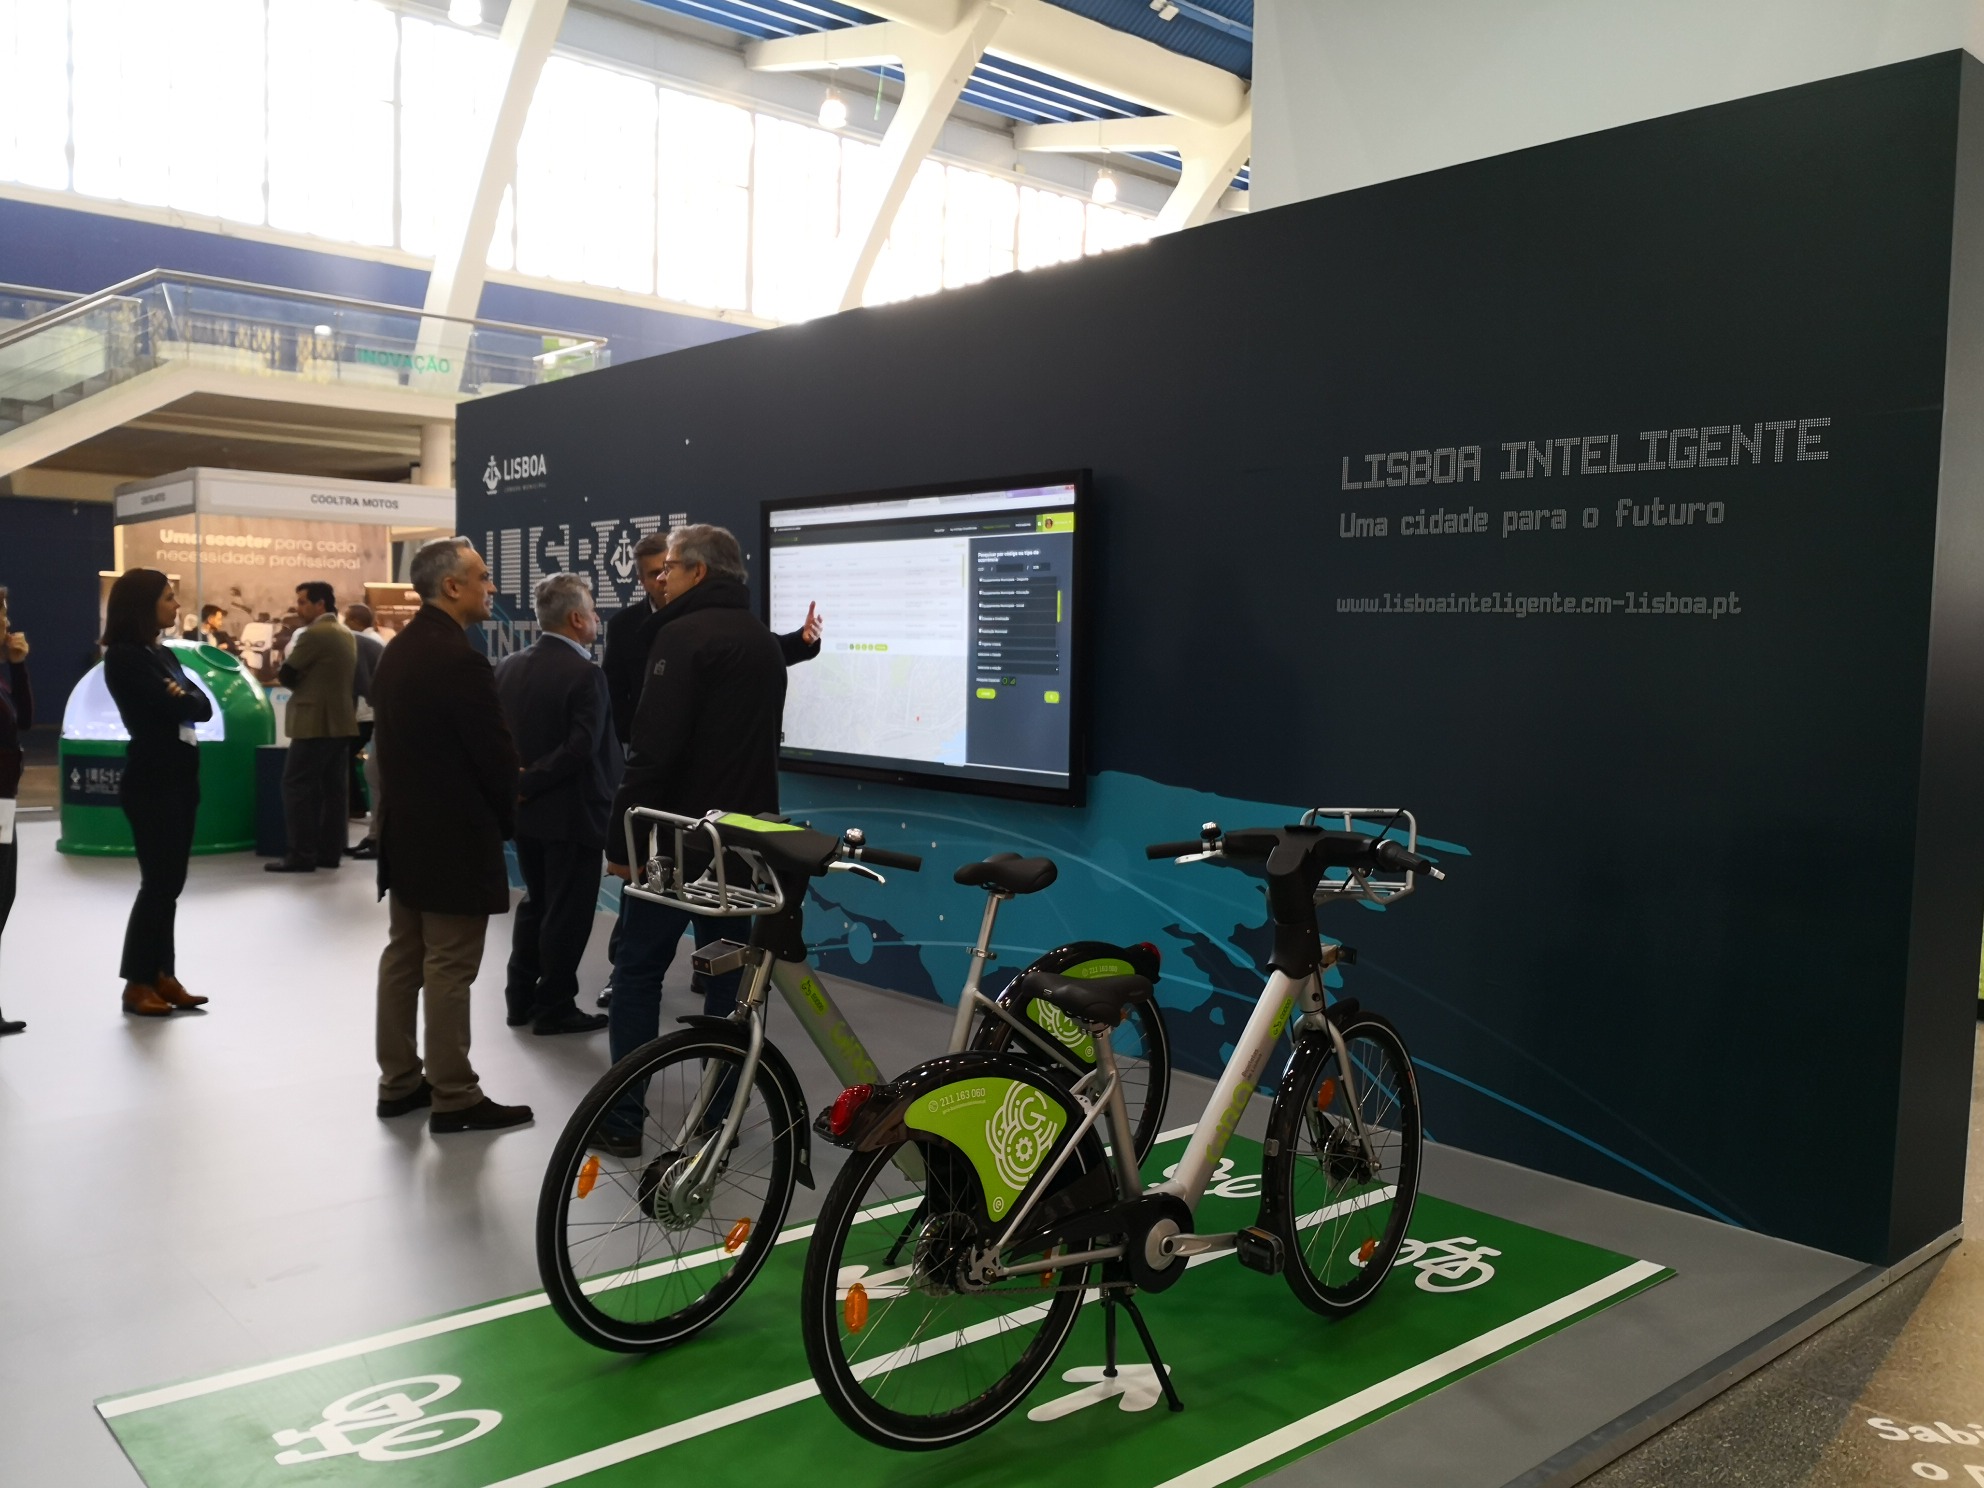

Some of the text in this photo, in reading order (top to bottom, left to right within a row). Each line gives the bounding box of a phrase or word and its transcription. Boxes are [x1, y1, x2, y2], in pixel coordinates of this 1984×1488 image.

[357, 347, 450, 374] INOVAÇÃO
[1341, 416, 1832, 490] LISBOA INTELIGENTE
[504, 454, 547, 481] LISBOA
[311, 494, 399, 509] COOLTRA MOTOS
[1339, 497, 1725, 539] Uma cidade para o futuro
[205, 533, 272, 549] scooter
[275, 538, 313, 551] para
[316, 539, 357, 553] cada
[270, 552, 361, 570] profissional
[1336, 591, 1742, 620] www.lisboainteligente.cm-lisboa.pt
[940, 1093, 955, 1107] 211
[956, 1090, 970, 1102] 163
[971, 1087, 986, 1098] 060
[1911, 1462, 1949, 1481] o
